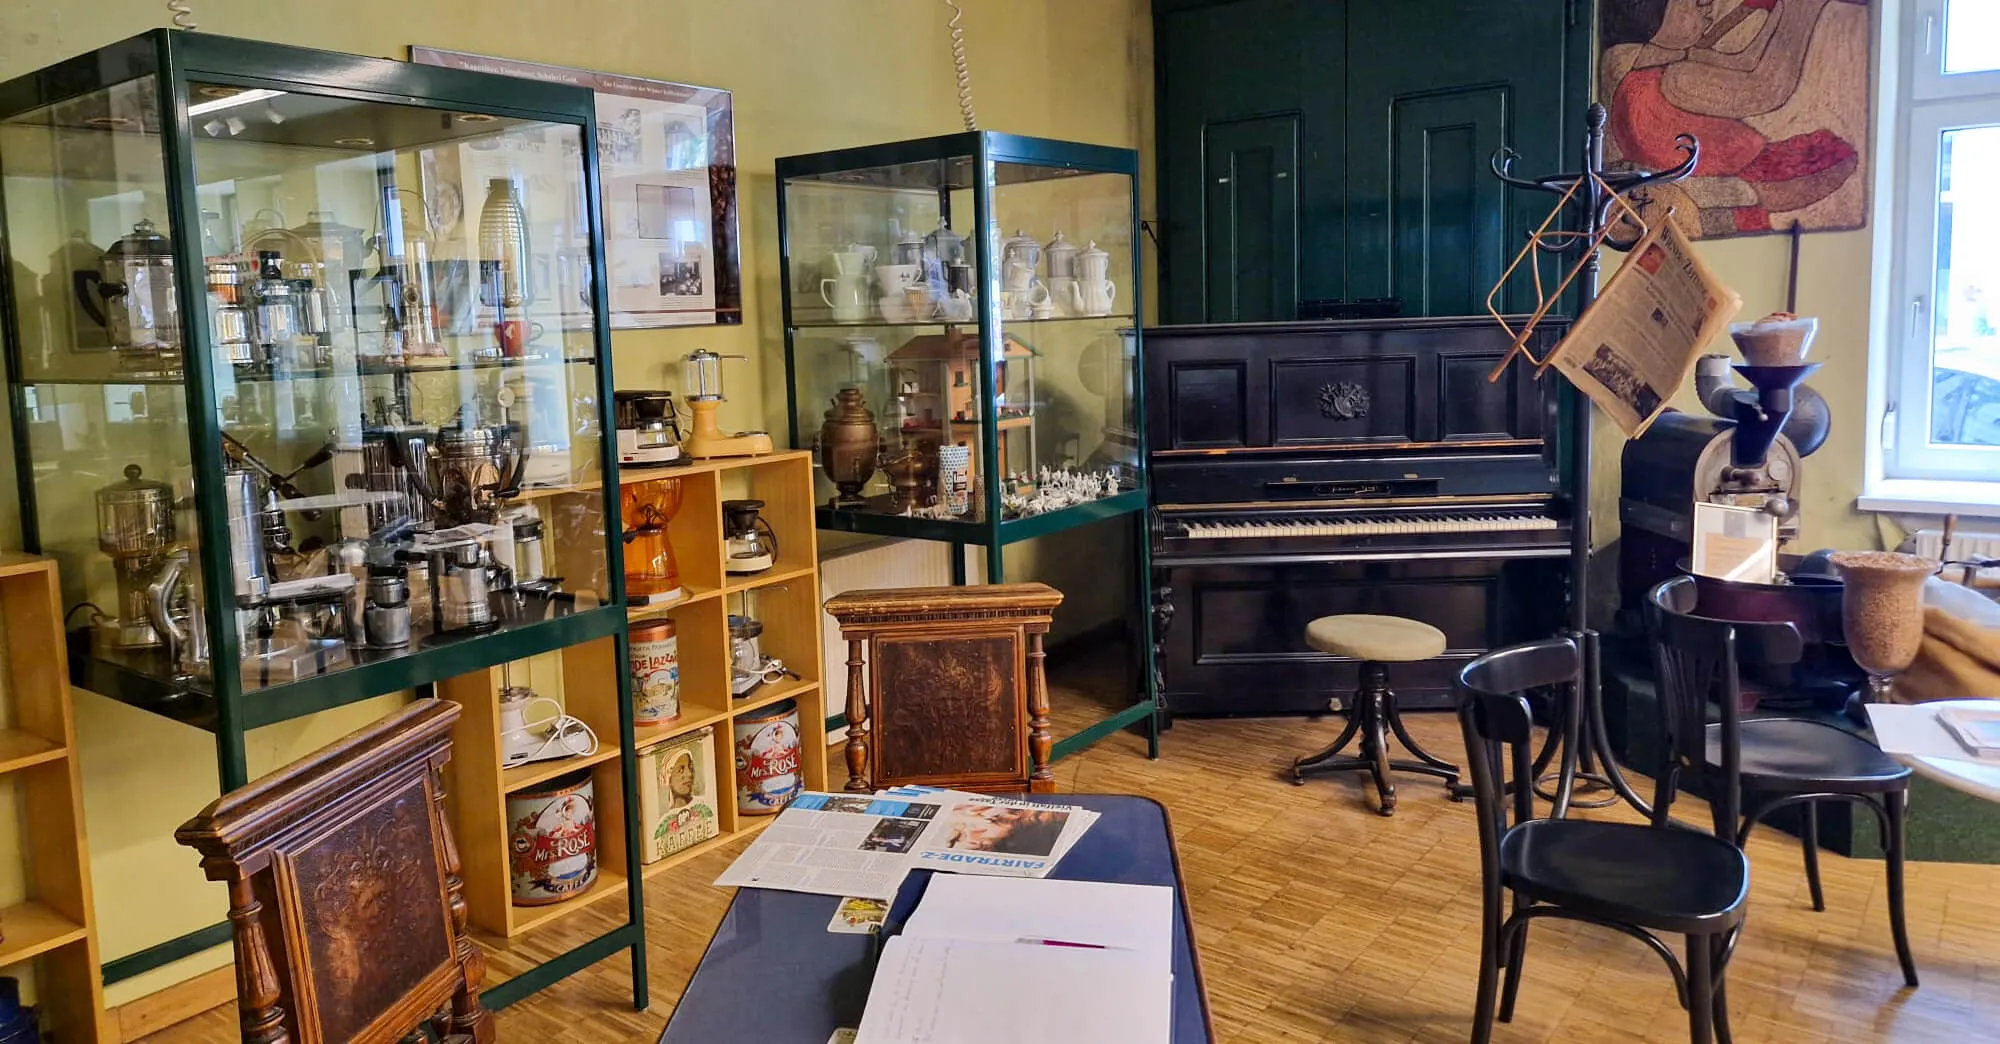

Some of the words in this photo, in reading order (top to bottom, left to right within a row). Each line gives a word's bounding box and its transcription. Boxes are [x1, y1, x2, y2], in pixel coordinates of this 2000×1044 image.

[764, 754, 797, 775] ROSE
[551, 831, 590, 857] ROSE
[656, 821, 713, 856] KAFFEE
